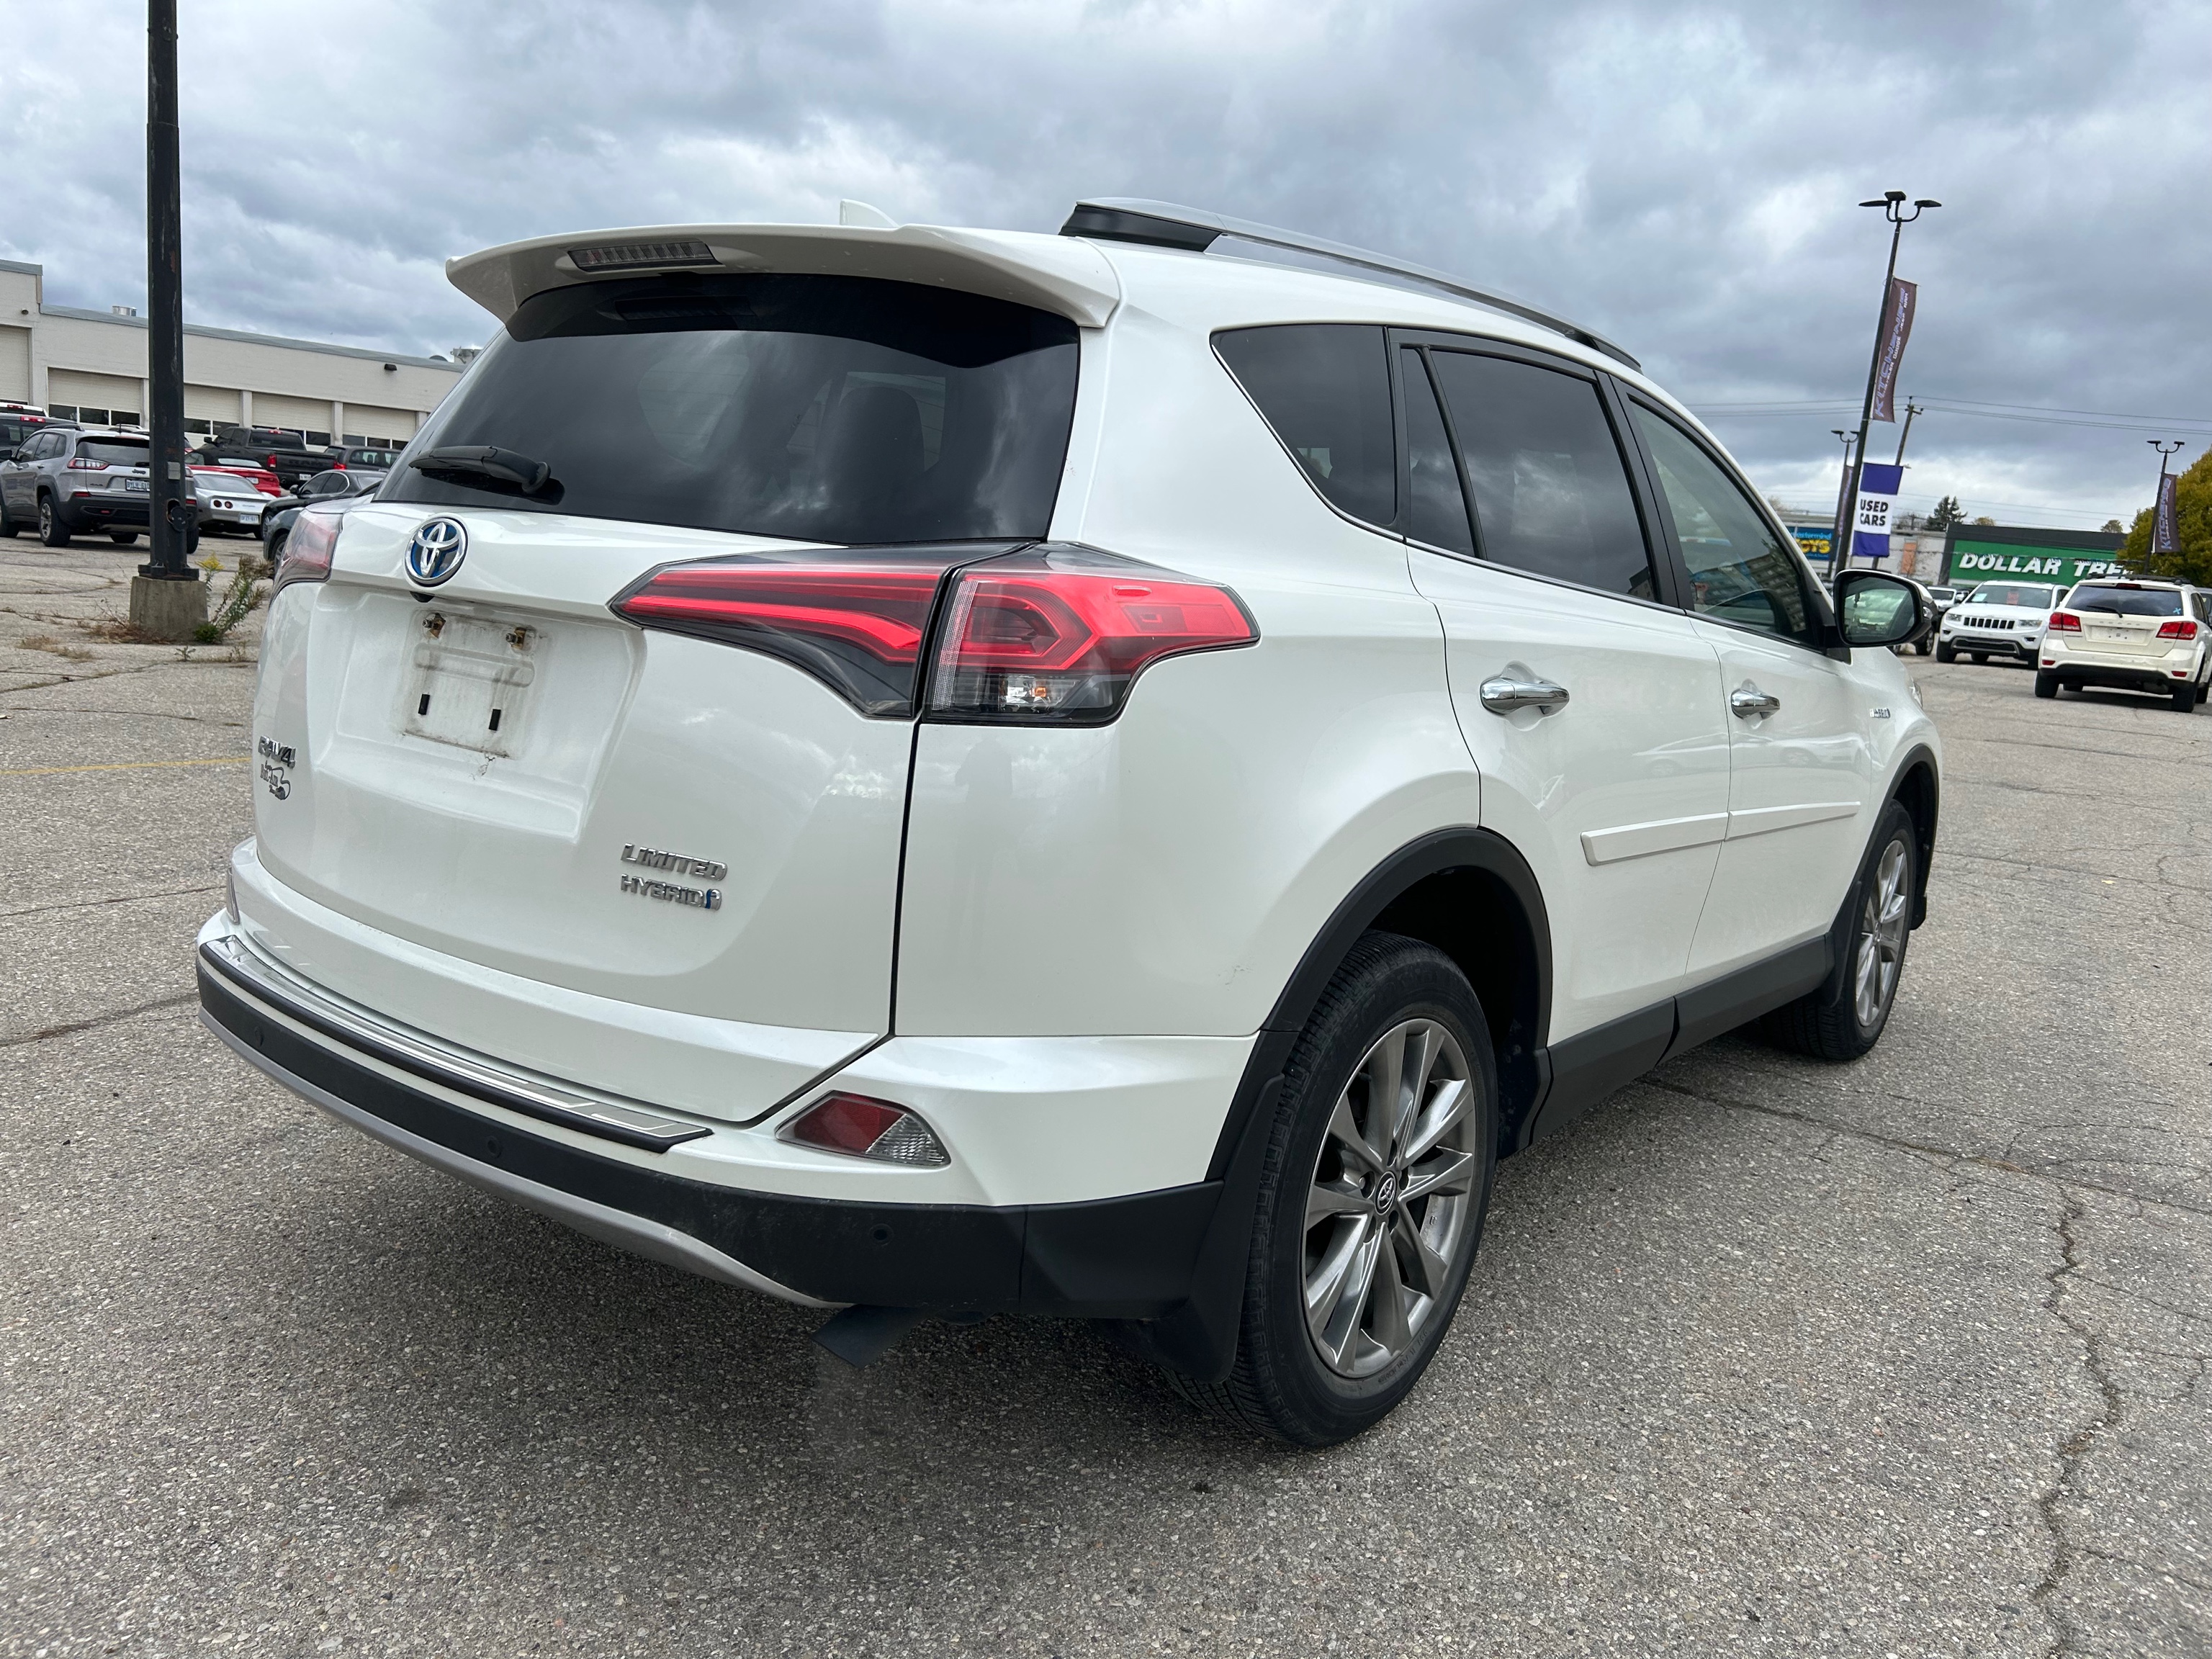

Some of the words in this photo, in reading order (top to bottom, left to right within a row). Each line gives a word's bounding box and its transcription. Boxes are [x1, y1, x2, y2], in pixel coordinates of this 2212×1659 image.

[1860, 498, 1889, 513] USED
[1860, 513, 1886, 526] CARS
[1959, 553, 2062, 575] DOLLAR
[2074, 559, 2134, 577] TRE
[258, 735, 296, 769] RAV4
[621, 842, 728, 881] LIMITED
[621, 873, 706, 908] HYBRID
